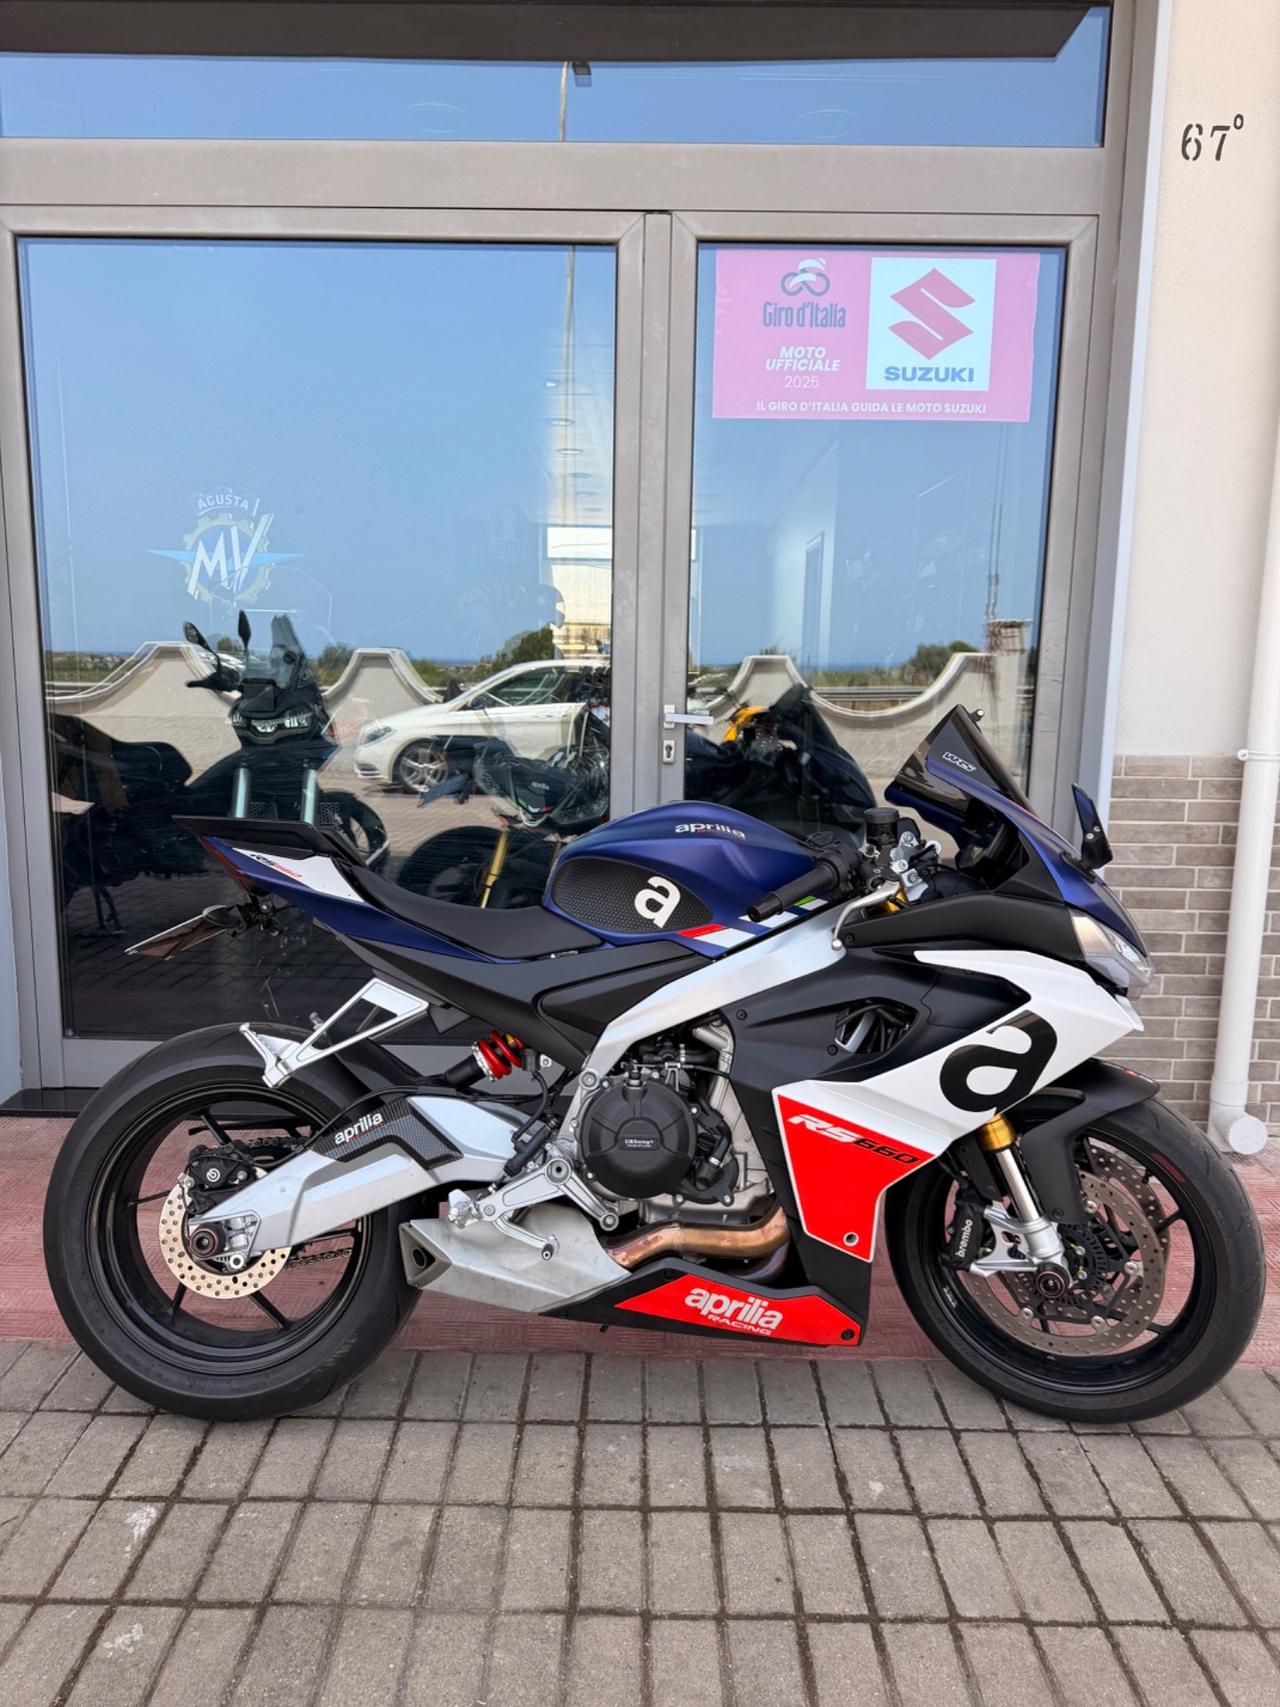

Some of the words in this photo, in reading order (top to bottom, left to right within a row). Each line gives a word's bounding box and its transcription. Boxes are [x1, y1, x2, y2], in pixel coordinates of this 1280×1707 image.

[762, 302, 795, 327] Giro
[796, 302, 846, 328] d'Italia
[779, 346, 827, 359] MOTO
[765, 359, 841, 372] UFFICIALE
[884, 366, 975, 382] SUZUKI
[784, 375, 820, 389] 2025
[756, 401, 765, 411] IL
[768, 401, 798, 412] GIRO
[800, 401, 849, 412] D'ITALIA
[851, 402, 888, 412] GUIDA
[891, 403, 903, 412] LE
[906, 403, 942, 413] MOTO
[944, 403, 986, 413] SUZUKI
[198, 494, 249, 511] AGUSTA
[187, 513, 270, 597] MV
[675, 823, 746, 841] aprilia
[634, 876, 680, 928] a
[940, 1009, 1057, 1116] a
[335, 1113, 383, 1145] aprilia
[955, 1219, 973, 1258] brembo
[684, 1287, 784, 1330] aprilia
[707, 1314, 773, 1335] RACING
